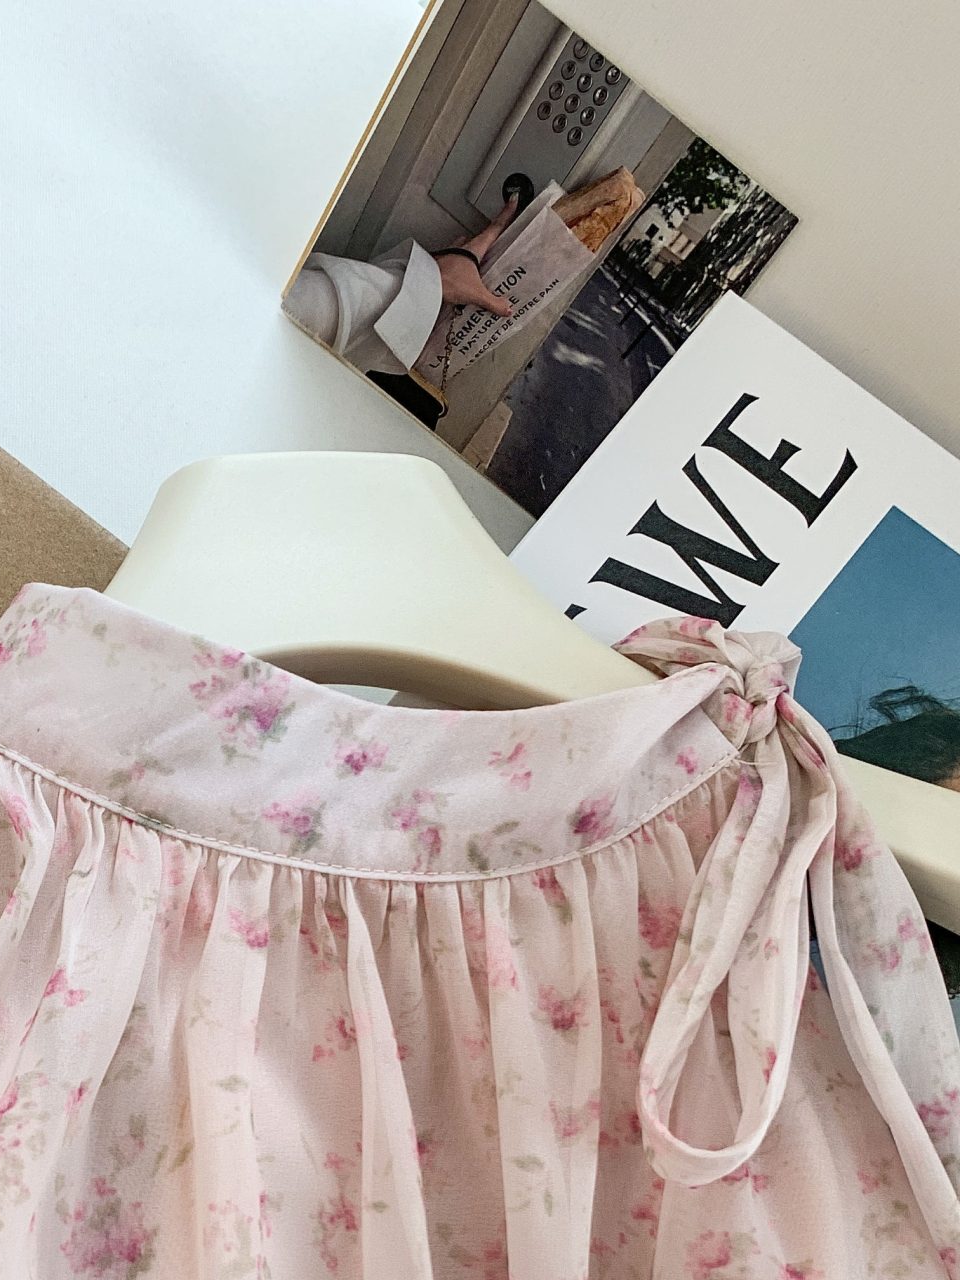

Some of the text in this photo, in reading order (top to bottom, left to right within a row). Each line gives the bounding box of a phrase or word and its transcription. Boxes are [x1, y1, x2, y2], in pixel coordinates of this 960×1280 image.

[501, 319, 514, 331] DE
[513, 296, 540, 320] NOTRE
[539, 278, 560, 298] PAIN
[564, 392, 858, 629] WE
